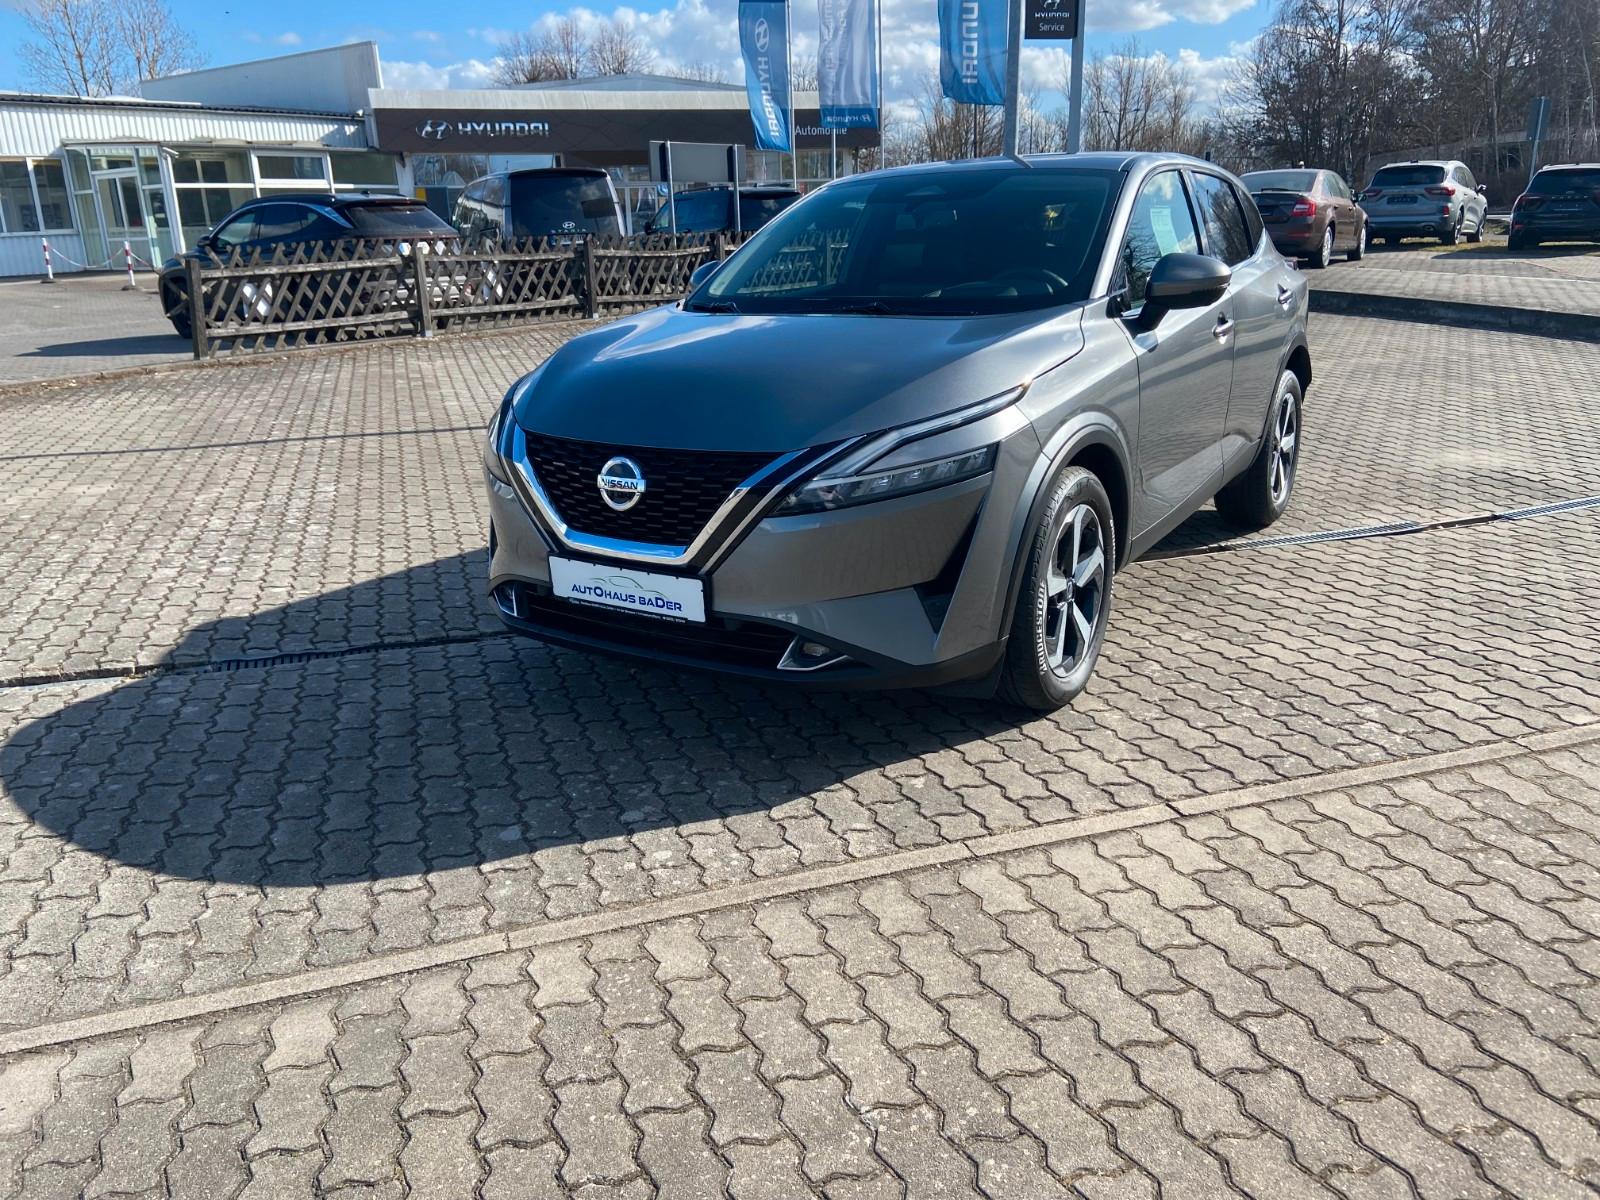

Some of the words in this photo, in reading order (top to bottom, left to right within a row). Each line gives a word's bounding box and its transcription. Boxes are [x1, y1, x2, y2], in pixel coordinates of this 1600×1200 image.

[1039, 23, 1065, 32] Service
[458, 122, 549, 137] HYUNDAI
[602, 478, 638, 490] NISSAN
[571, 583, 636, 603] AUTOHAUS
[638, 597, 682, 612] BADER
[1034, 578, 1048, 674] BRIDGESTONE
